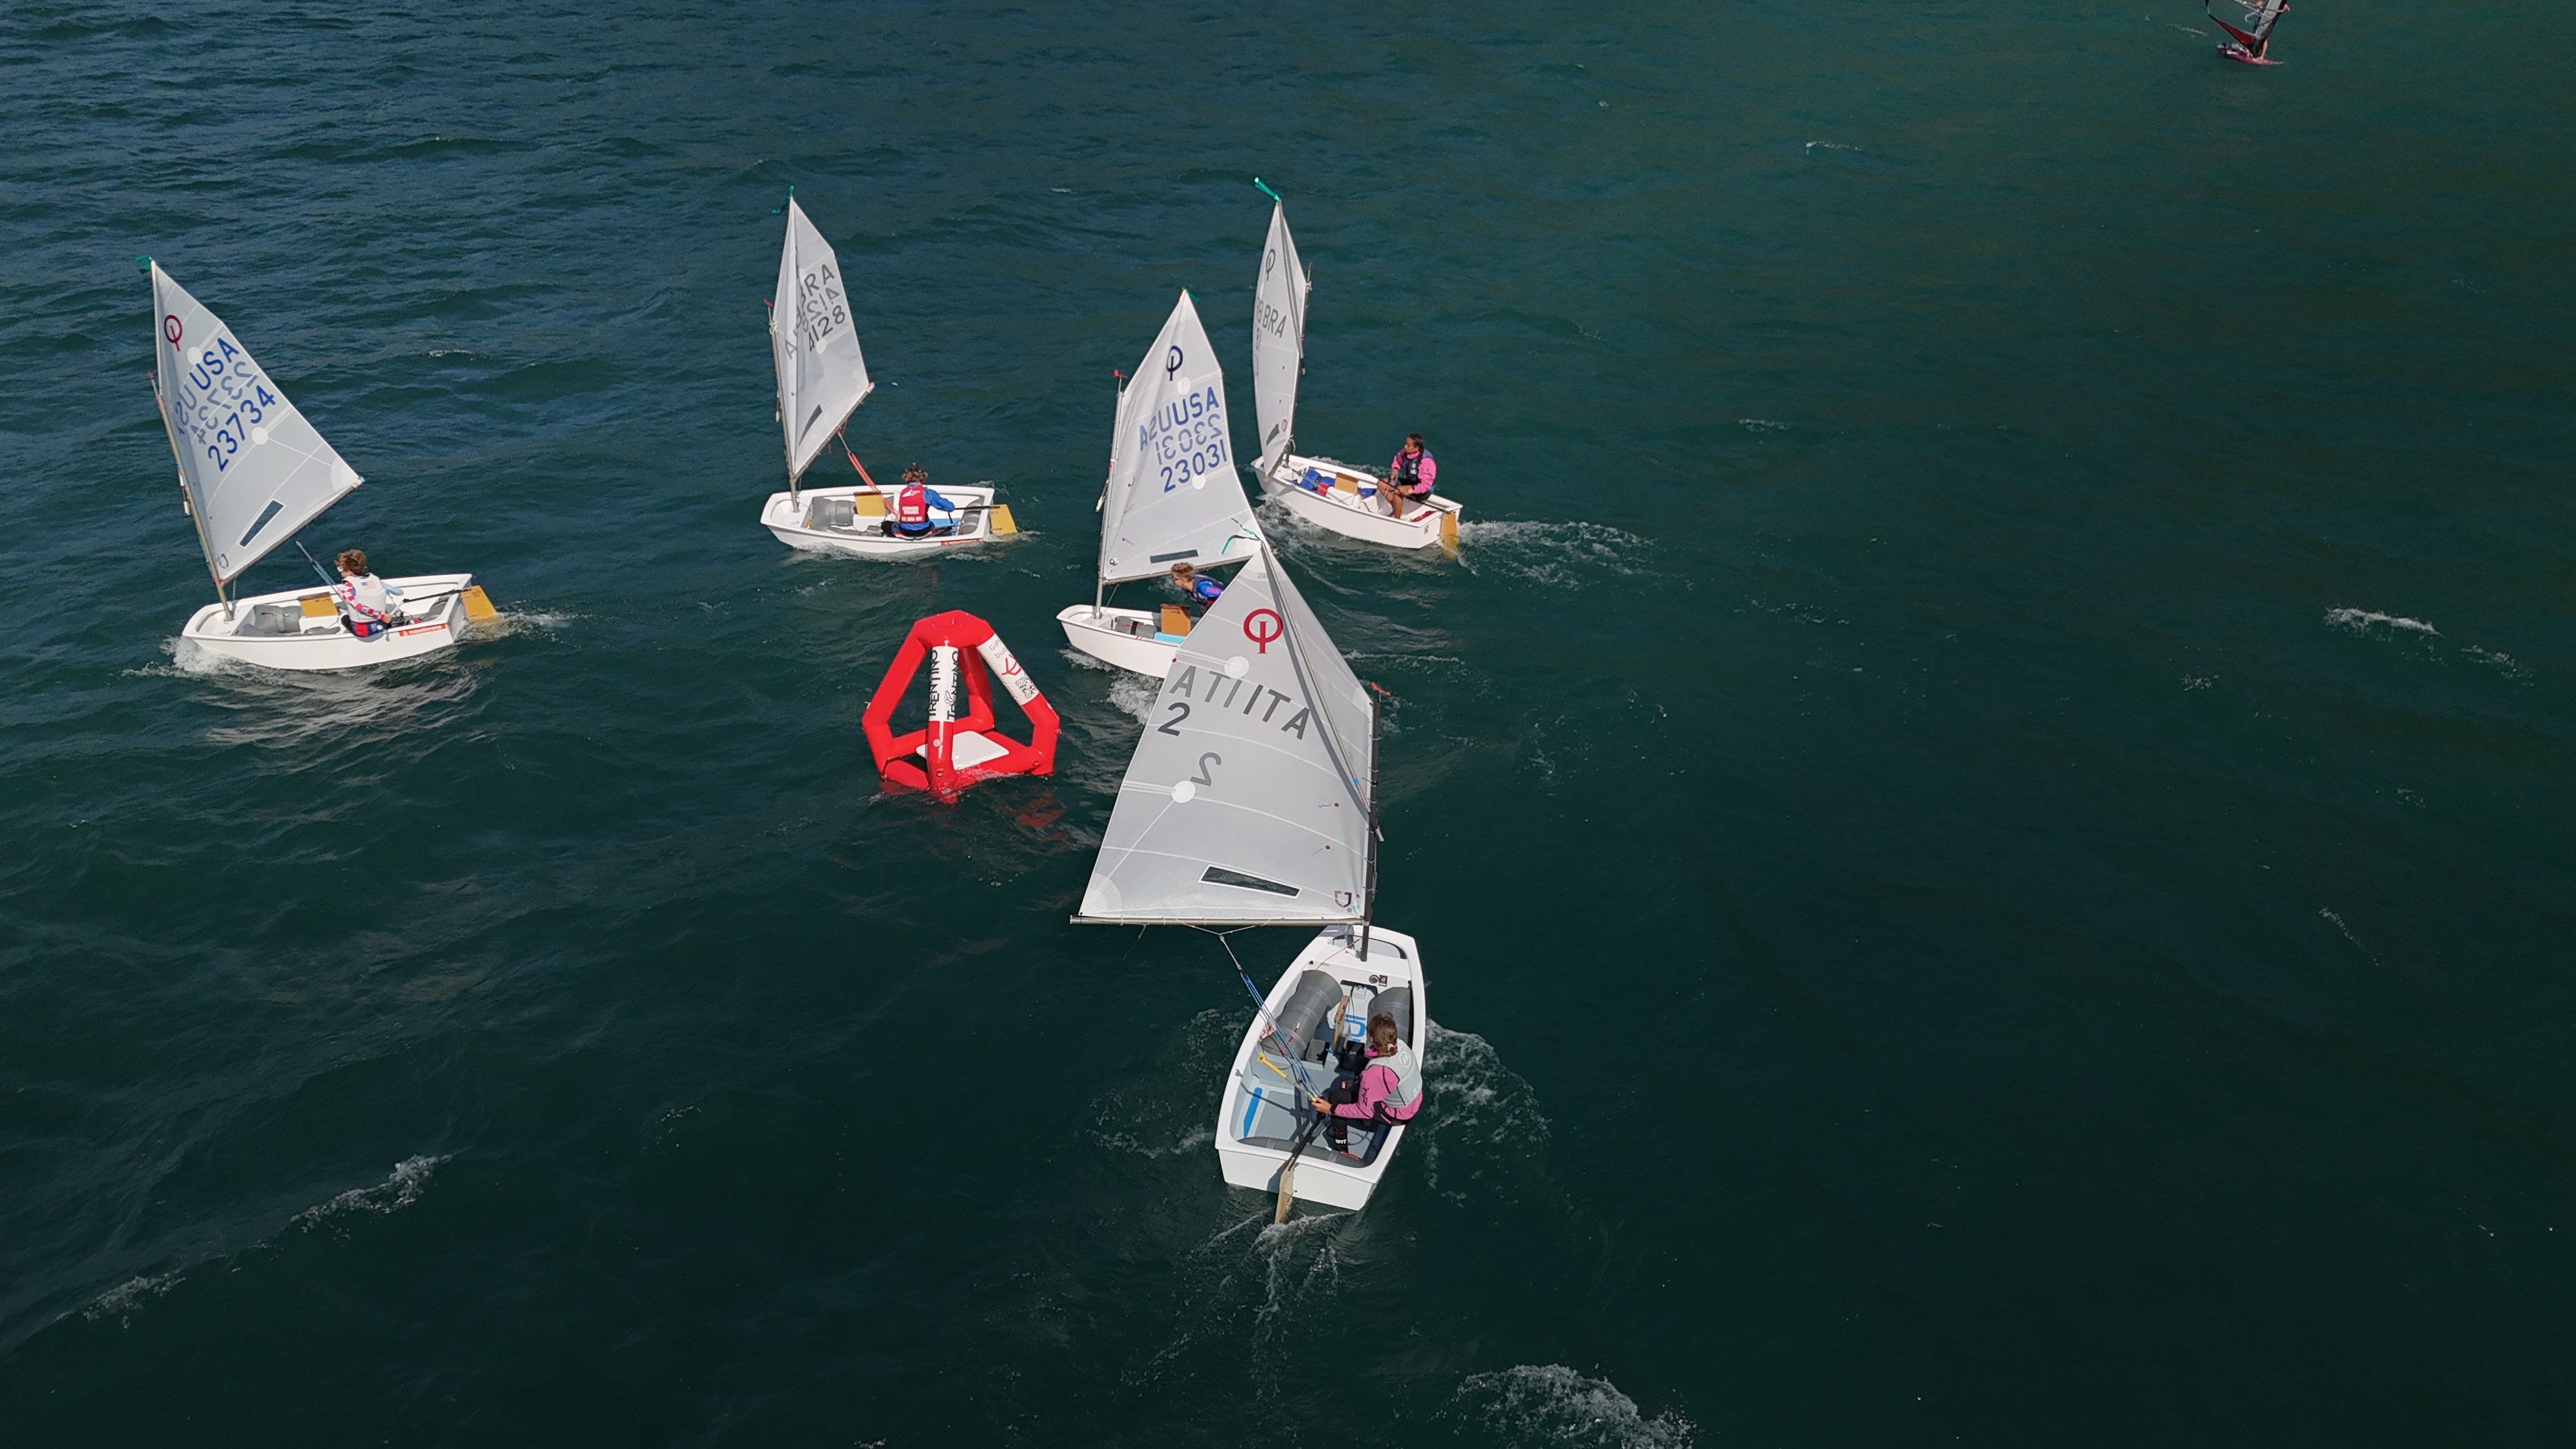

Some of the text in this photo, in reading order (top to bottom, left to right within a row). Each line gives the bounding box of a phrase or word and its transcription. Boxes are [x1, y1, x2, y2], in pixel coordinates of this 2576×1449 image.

[808, 305, 846, 352] 4128
[1262, 304, 1287, 339] BRA
[189, 337, 240, 390] USA
[208, 385, 276, 471] 23734
[1172, 387, 1220, 425] USA
[1160, 439, 1227, 493] 23031
[1157, 702, 1191, 736] 2
[1243, 684, 1311, 740] ITA
